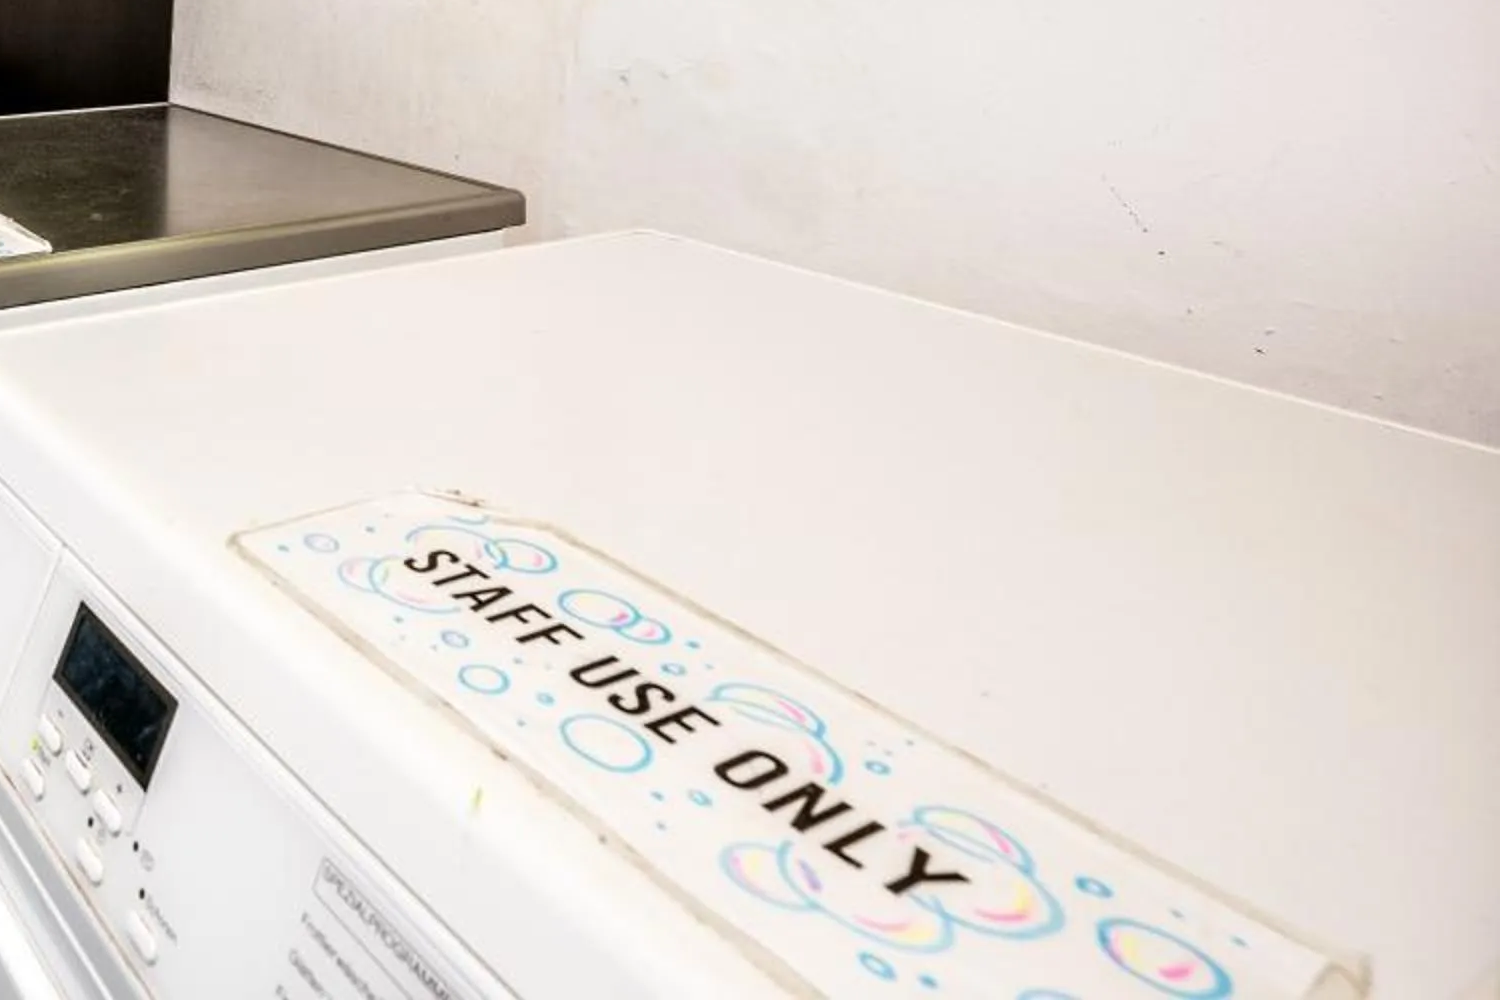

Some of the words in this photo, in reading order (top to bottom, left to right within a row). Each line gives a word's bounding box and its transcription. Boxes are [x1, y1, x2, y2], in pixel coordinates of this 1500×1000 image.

[403, 549, 584, 646] STAFF
[569, 655, 722, 744] USE
[713, 750, 972, 897] ONLY
